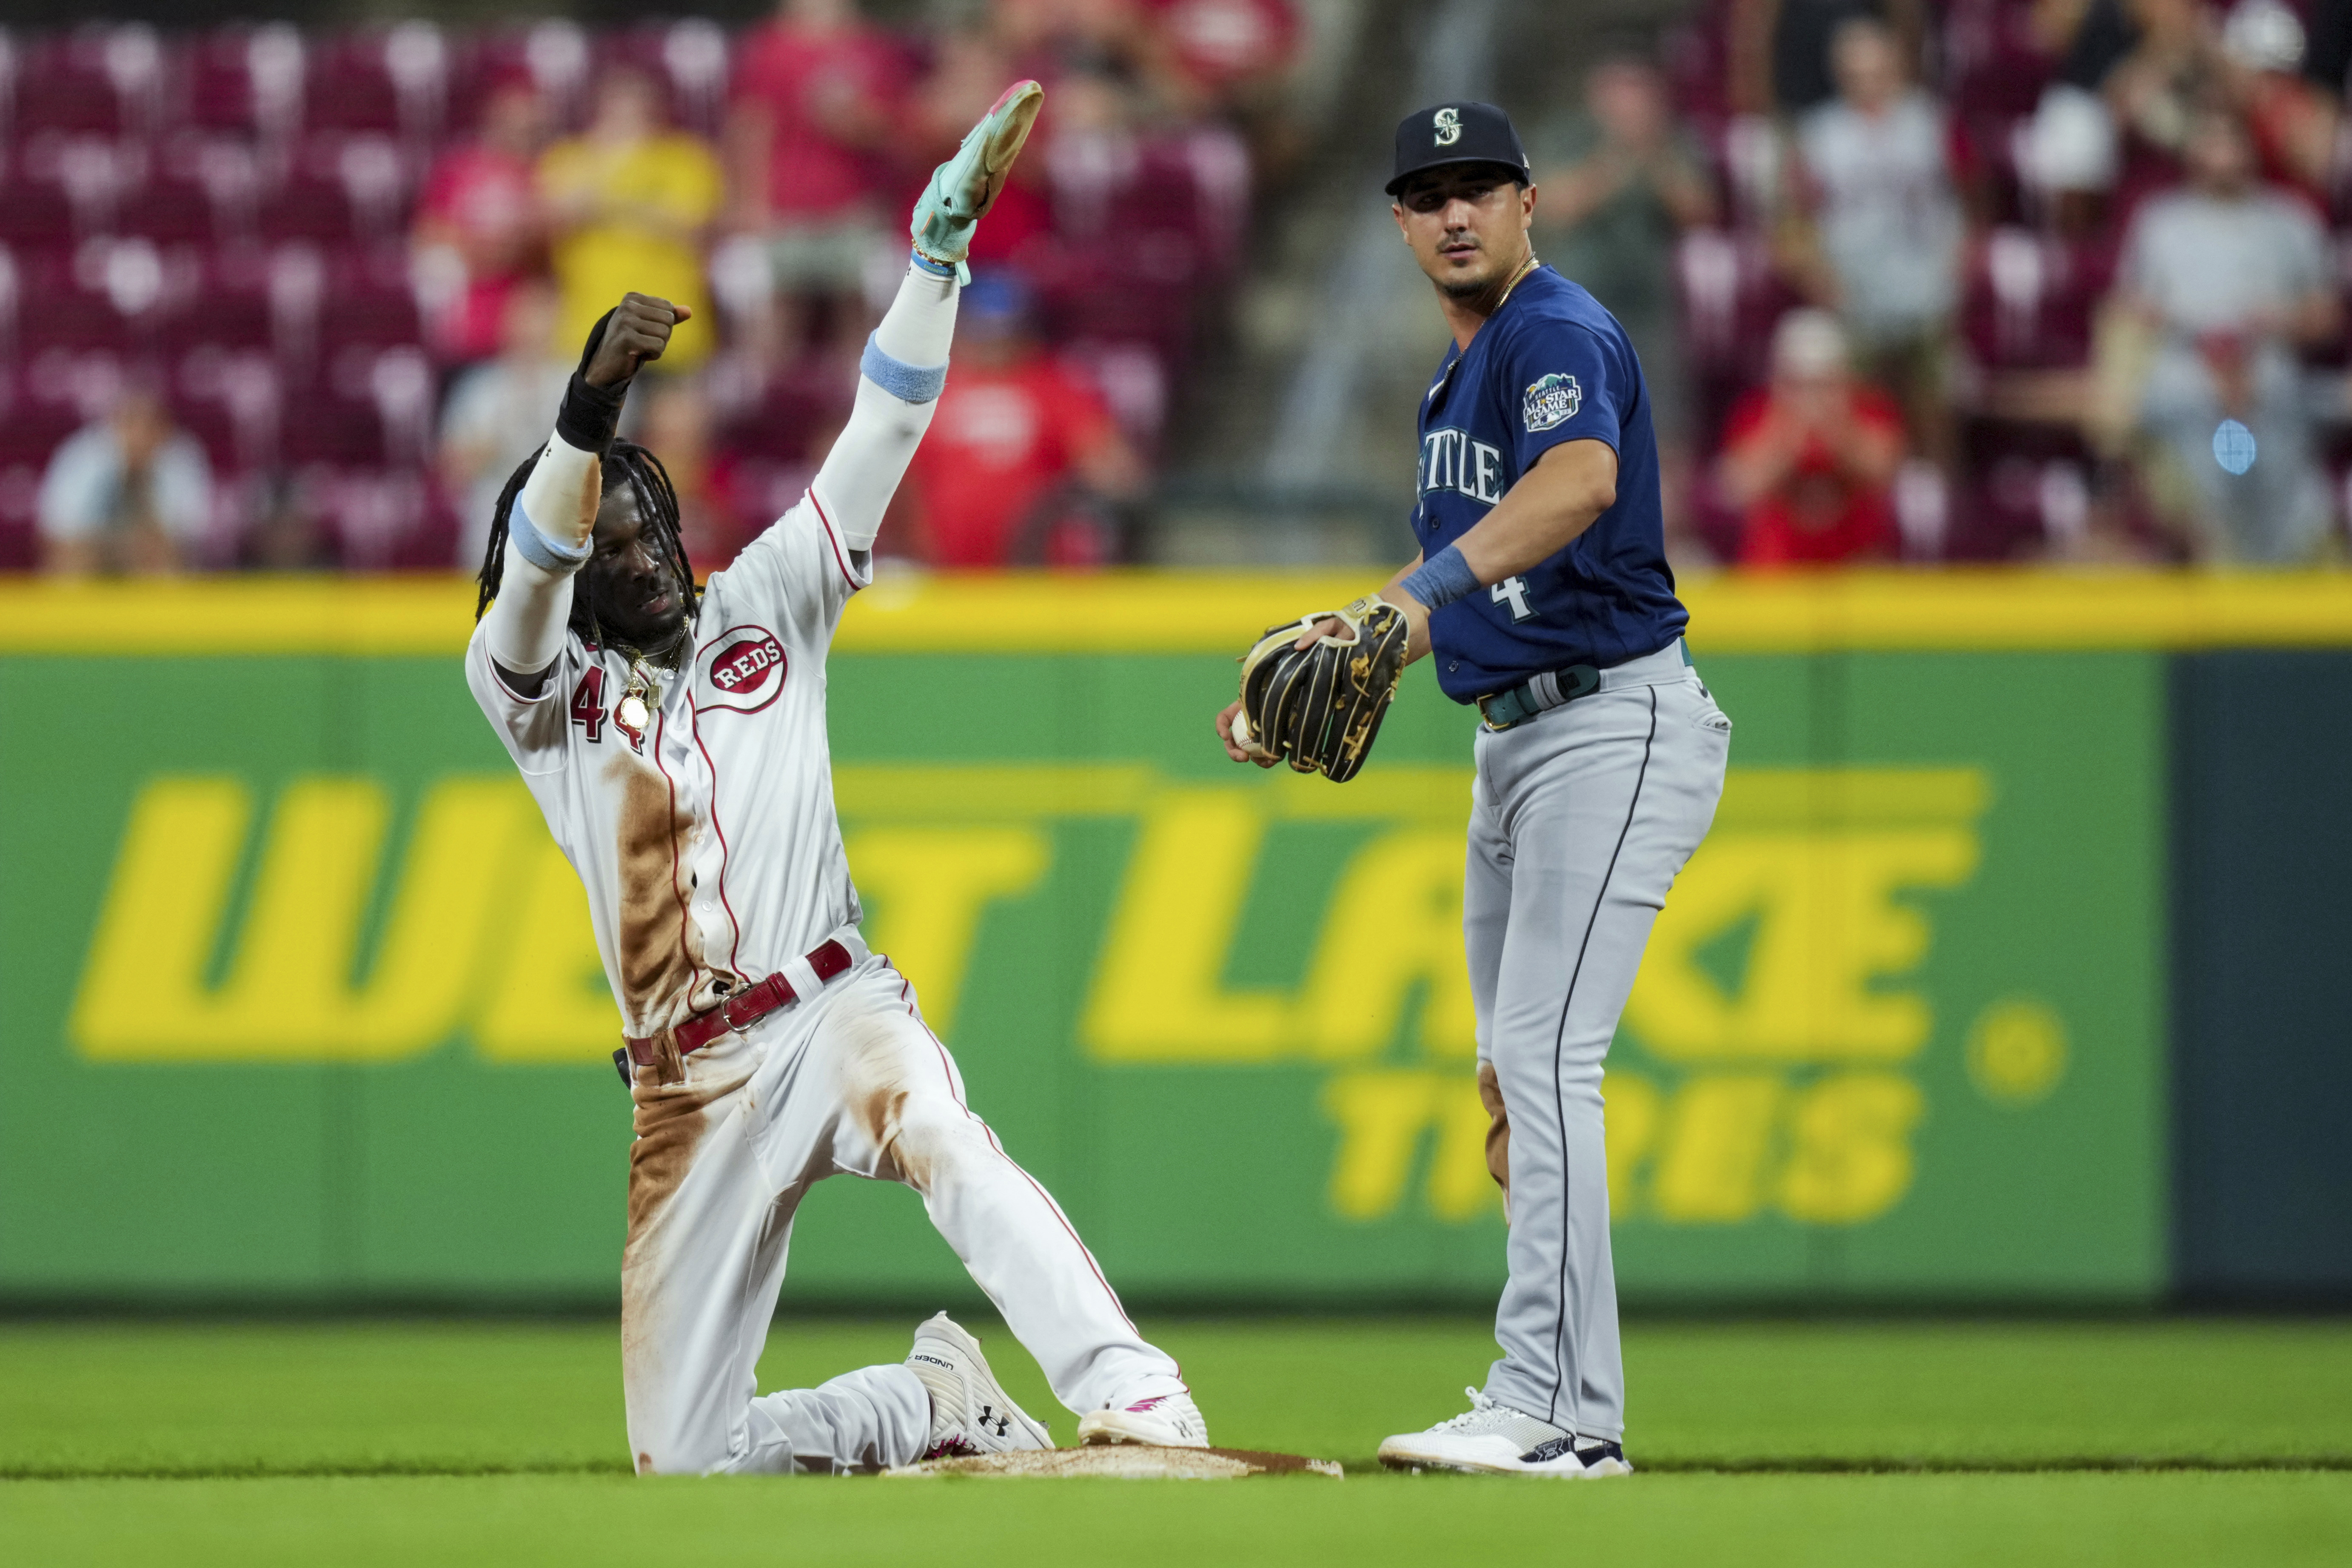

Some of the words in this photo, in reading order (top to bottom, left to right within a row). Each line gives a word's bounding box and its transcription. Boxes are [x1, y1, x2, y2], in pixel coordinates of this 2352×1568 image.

[1525, 399, 1545, 419] ALL
[1545, 388, 1578, 405] STAR
[1533, 399, 1567, 420] GAME
[1535, 386, 1560, 399] SEATTLE
[1417, 427, 1502, 507] TTLE
[714, 640, 781, 689] REDS
[570, 664, 644, 757] 44
[68, 774, 1055, 1063] WET
[915, 1354, 954, 1371] UNDER
